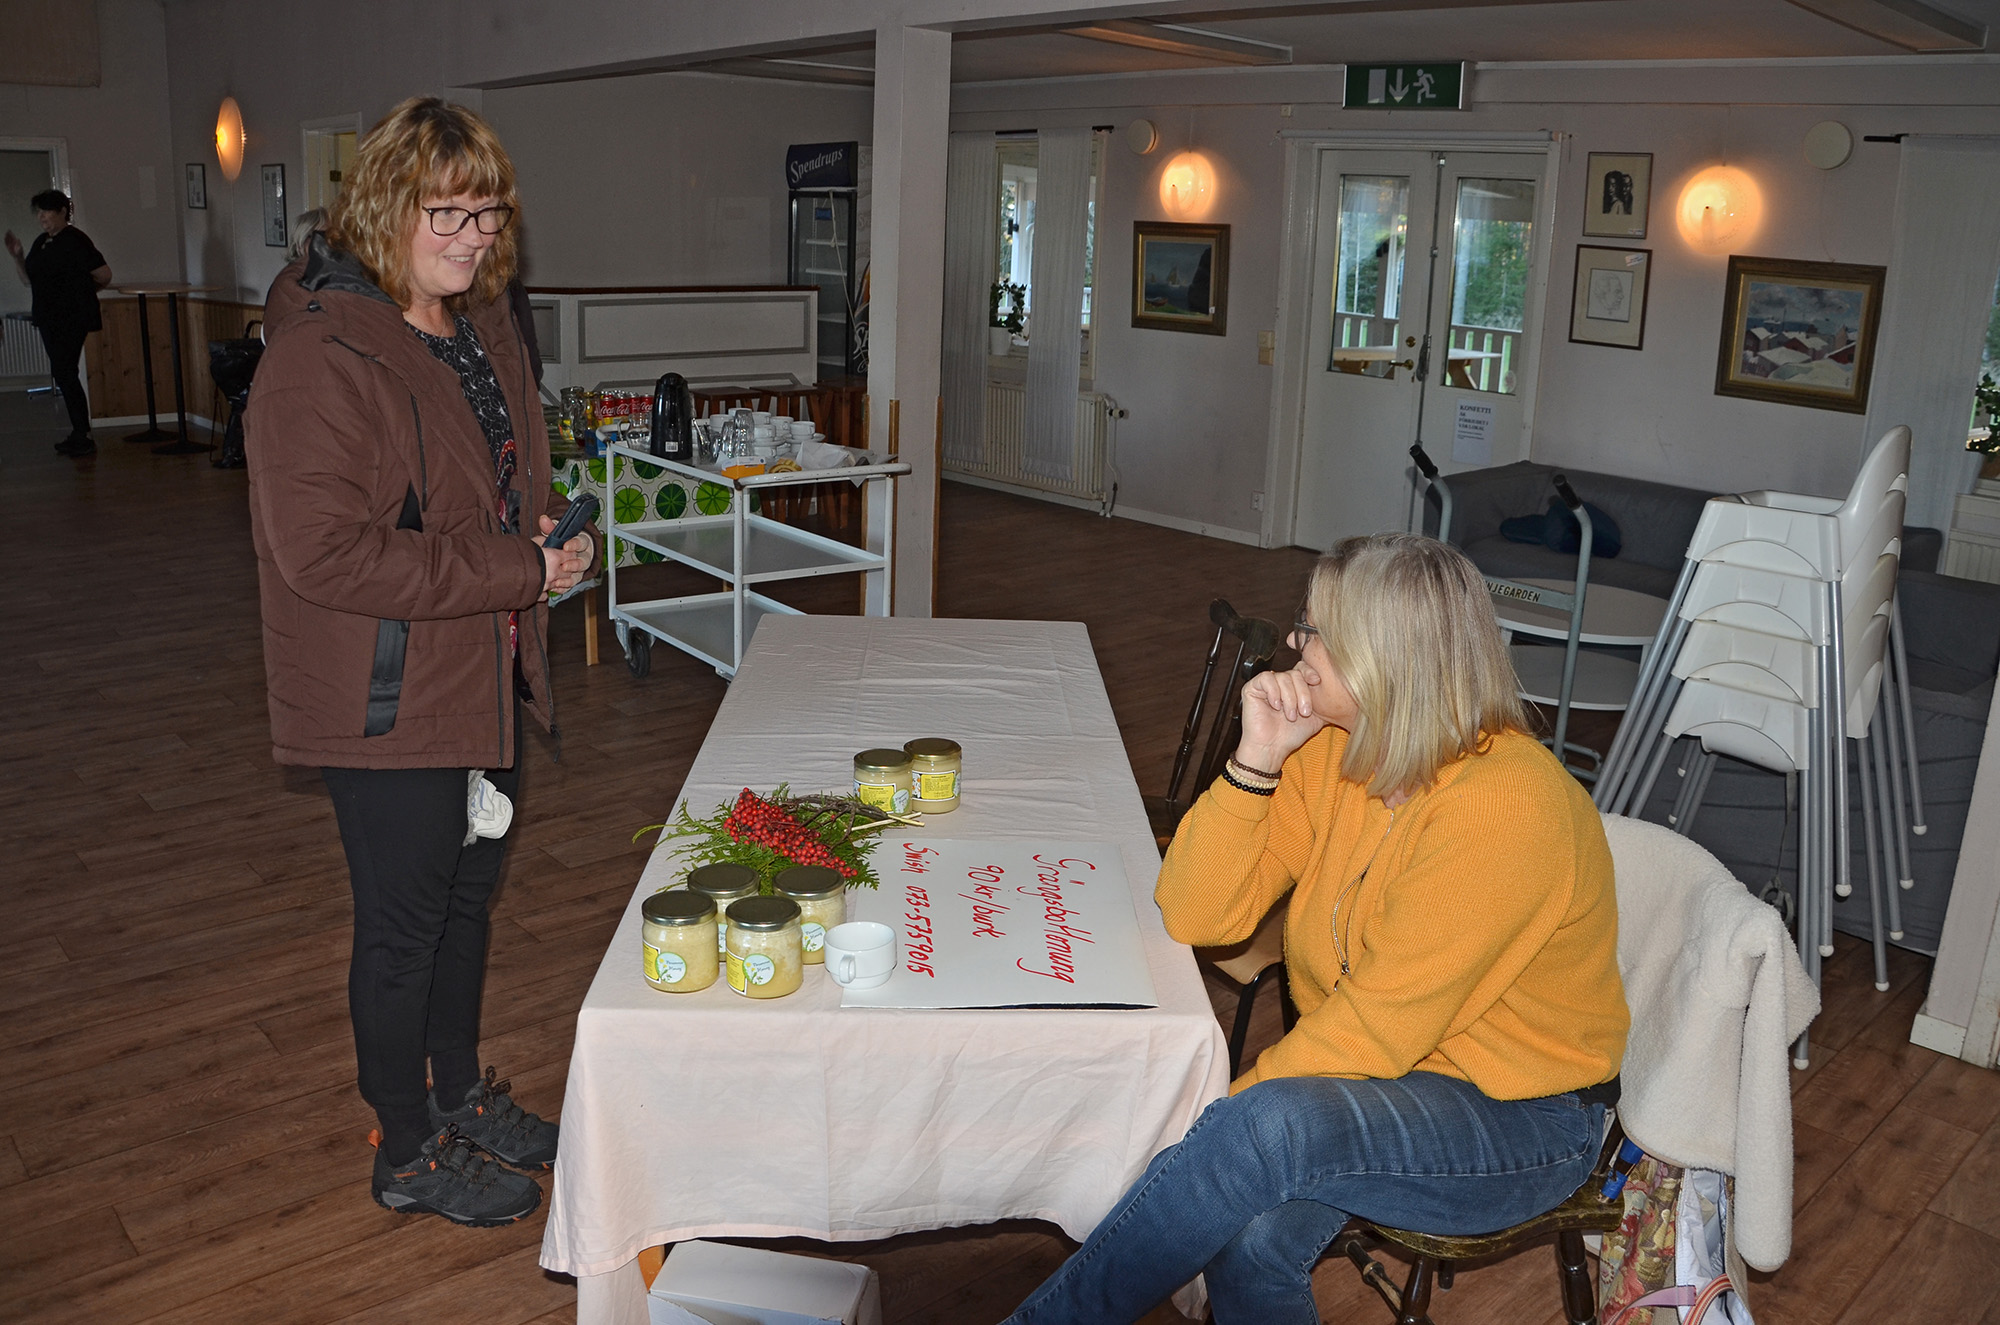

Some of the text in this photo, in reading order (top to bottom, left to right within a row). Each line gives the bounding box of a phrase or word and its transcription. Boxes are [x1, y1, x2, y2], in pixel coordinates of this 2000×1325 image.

[790, 148, 844, 184] Spendrups
[1460, 405, 1491, 413] KONFETTI
[1486, 581, 1541, 602] NJEGARDEN
[901, 842, 939, 874] Swish
